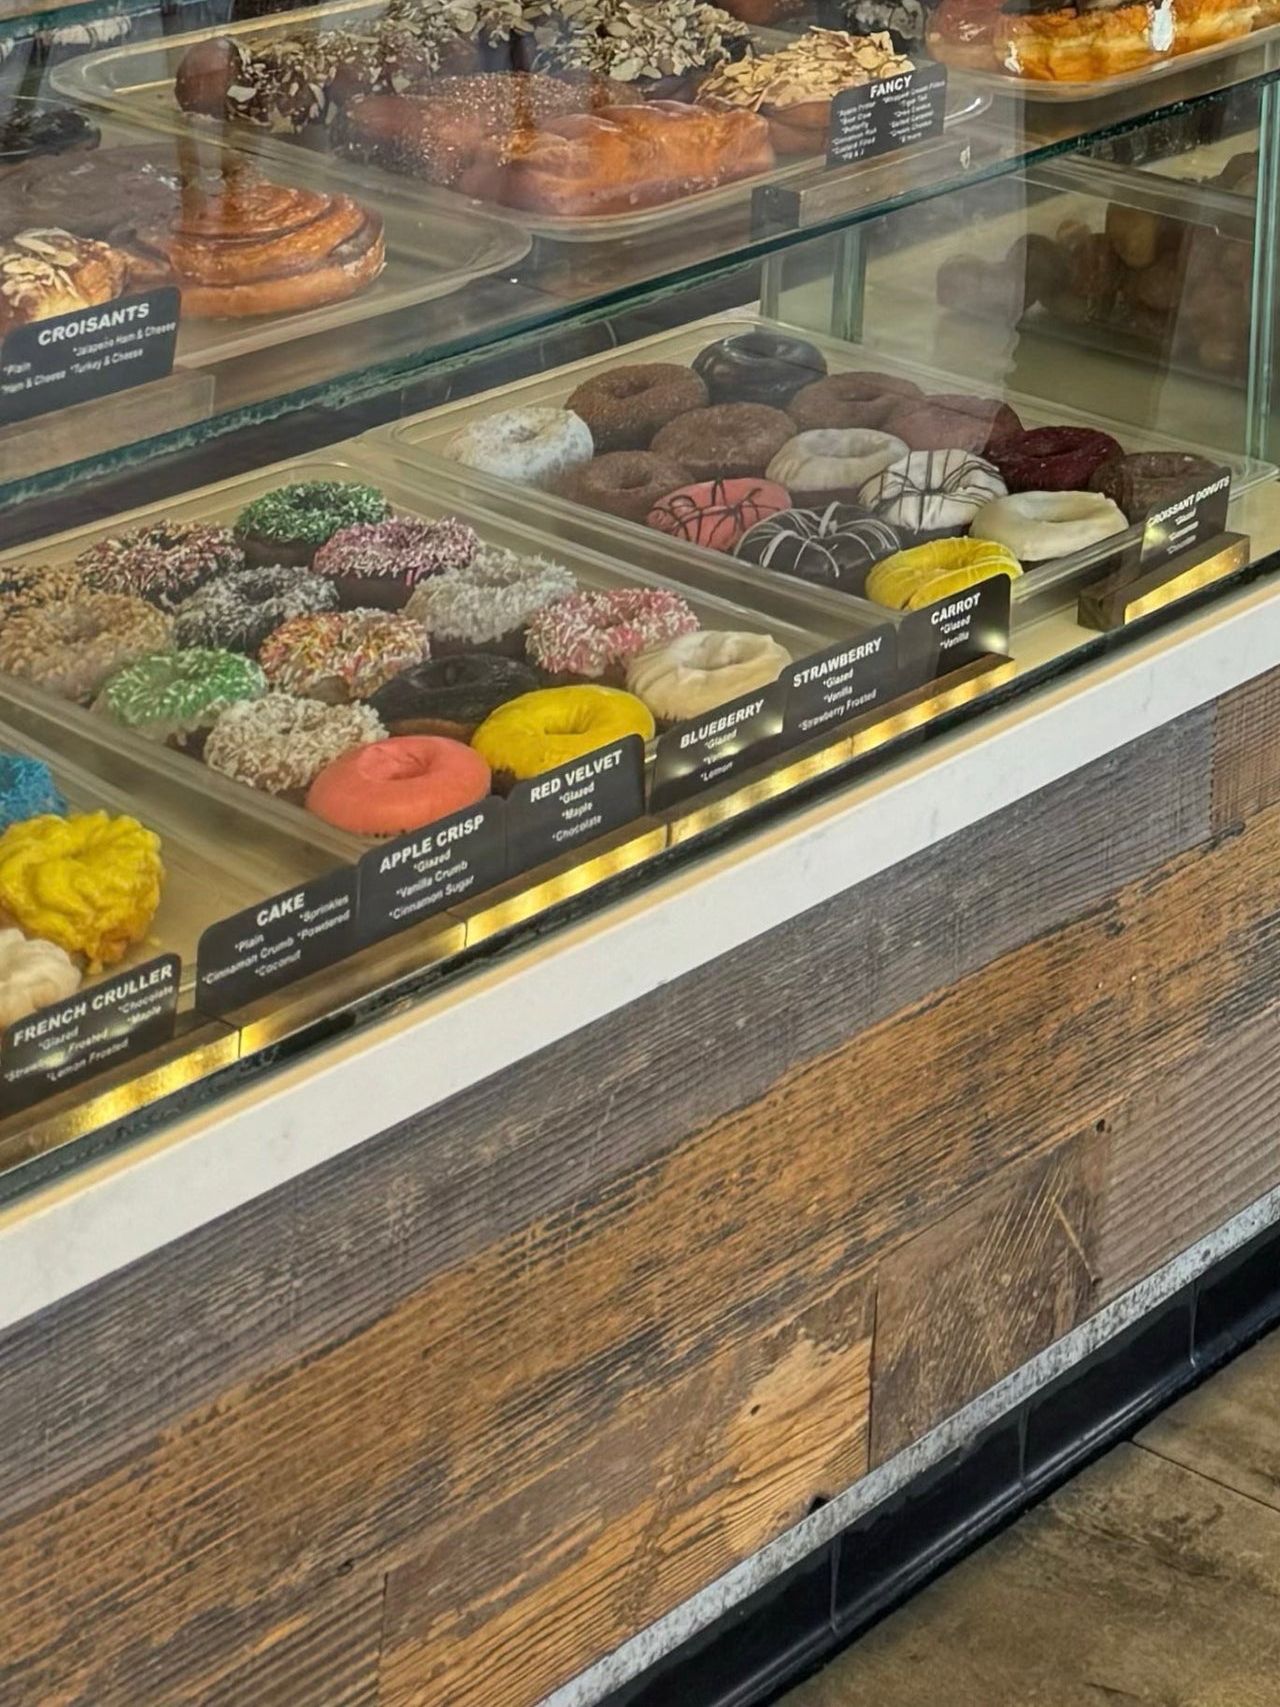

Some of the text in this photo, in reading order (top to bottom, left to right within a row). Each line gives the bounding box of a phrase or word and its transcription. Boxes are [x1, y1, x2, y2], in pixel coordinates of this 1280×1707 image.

[870, 74, 913, 99] FANCY
[37, 302, 150, 346] CROISANTS
[144, 322, 177, 338] Cheese
[111, 348, 144, 364] Cheese
[34, 370, 67, 386] Cheese
[930, 592, 981, 626] CARROT
[793, 636, 882, 688] STRAWBERRY
[846, 688, 877, 711] Frosted
[680, 698, 765, 749] BLUEBERRY
[530, 749, 623, 803] RED VELVET
[380, 814, 484, 874] APPLE CRISP
[435, 860, 468, 882] Crumb
[445, 875, 474, 896] Sugar
[256, 892, 305, 927] CAKE
[260, 936, 294, 959] Crumb
[13, 963, 173, 1047] FRENCH CRULLER
[68, 1028, 109, 1054] Frosted
[89, 1038, 129, 1064] Frosted
